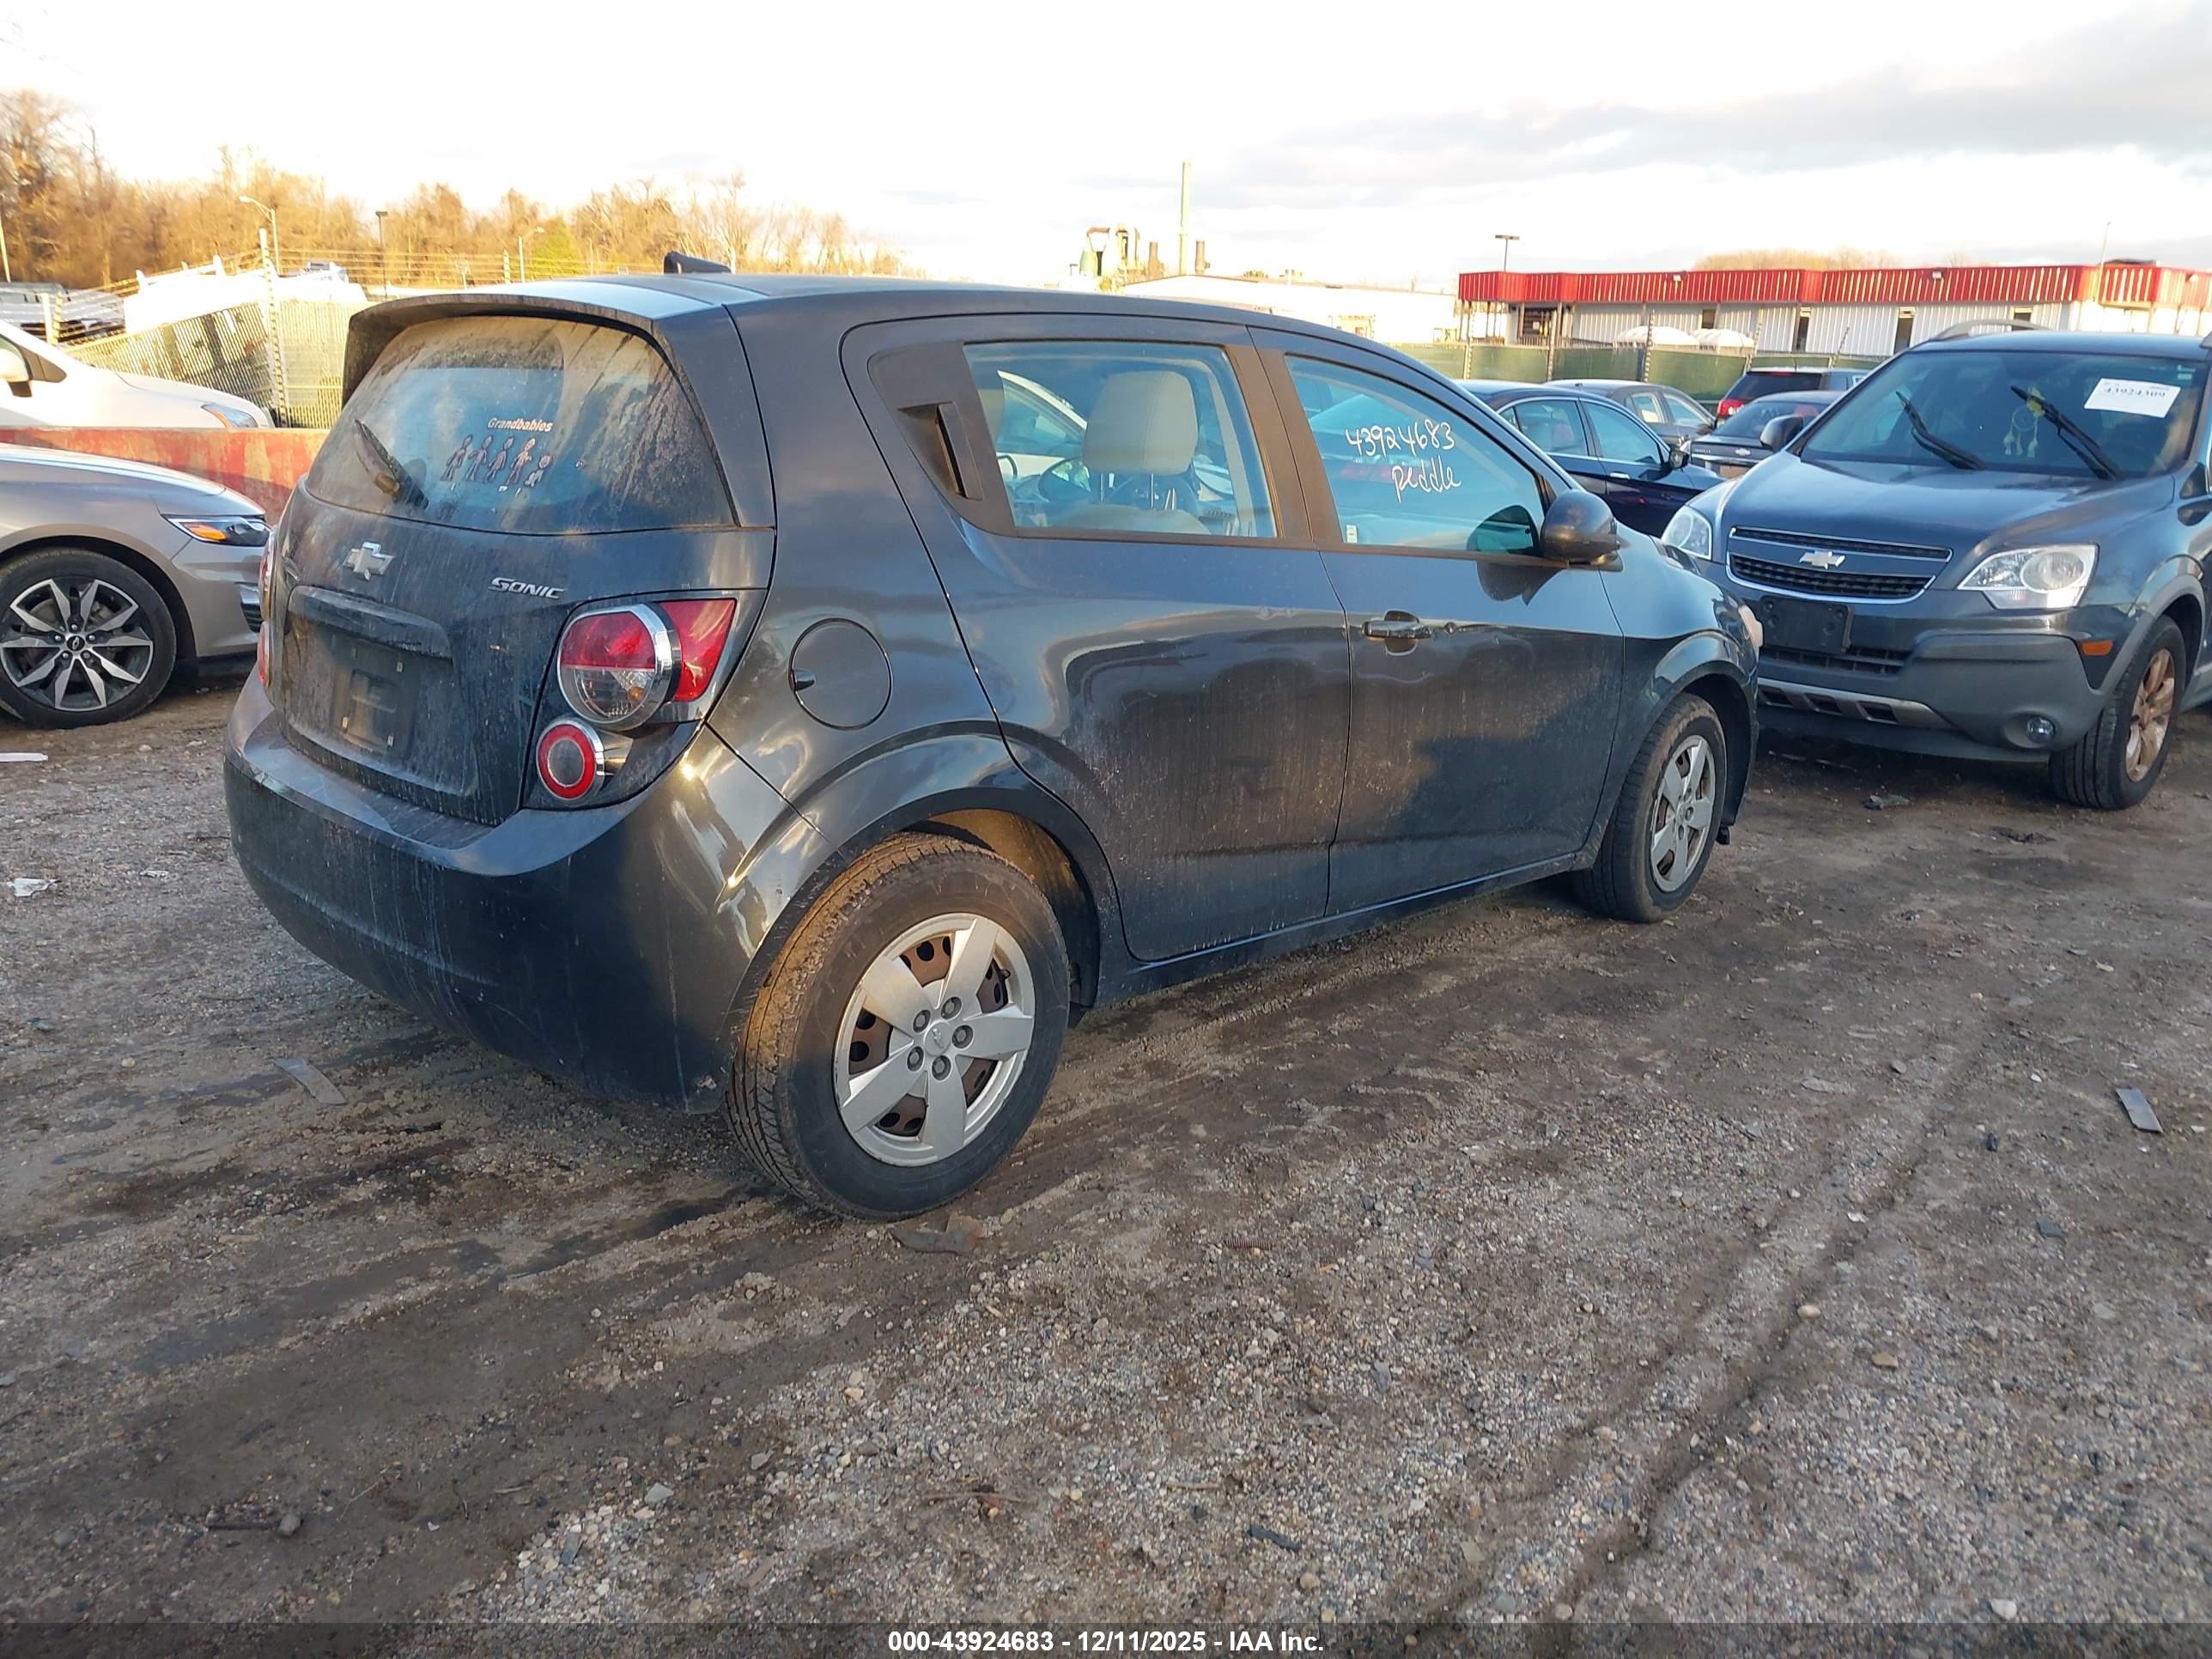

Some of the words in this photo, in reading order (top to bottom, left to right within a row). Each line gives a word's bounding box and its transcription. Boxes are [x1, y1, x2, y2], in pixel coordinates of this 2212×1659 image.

[487, 417, 554, 432] Grandbabies
[1346, 419, 1455, 457] 43924683
[488, 577, 565, 599] SONIC
